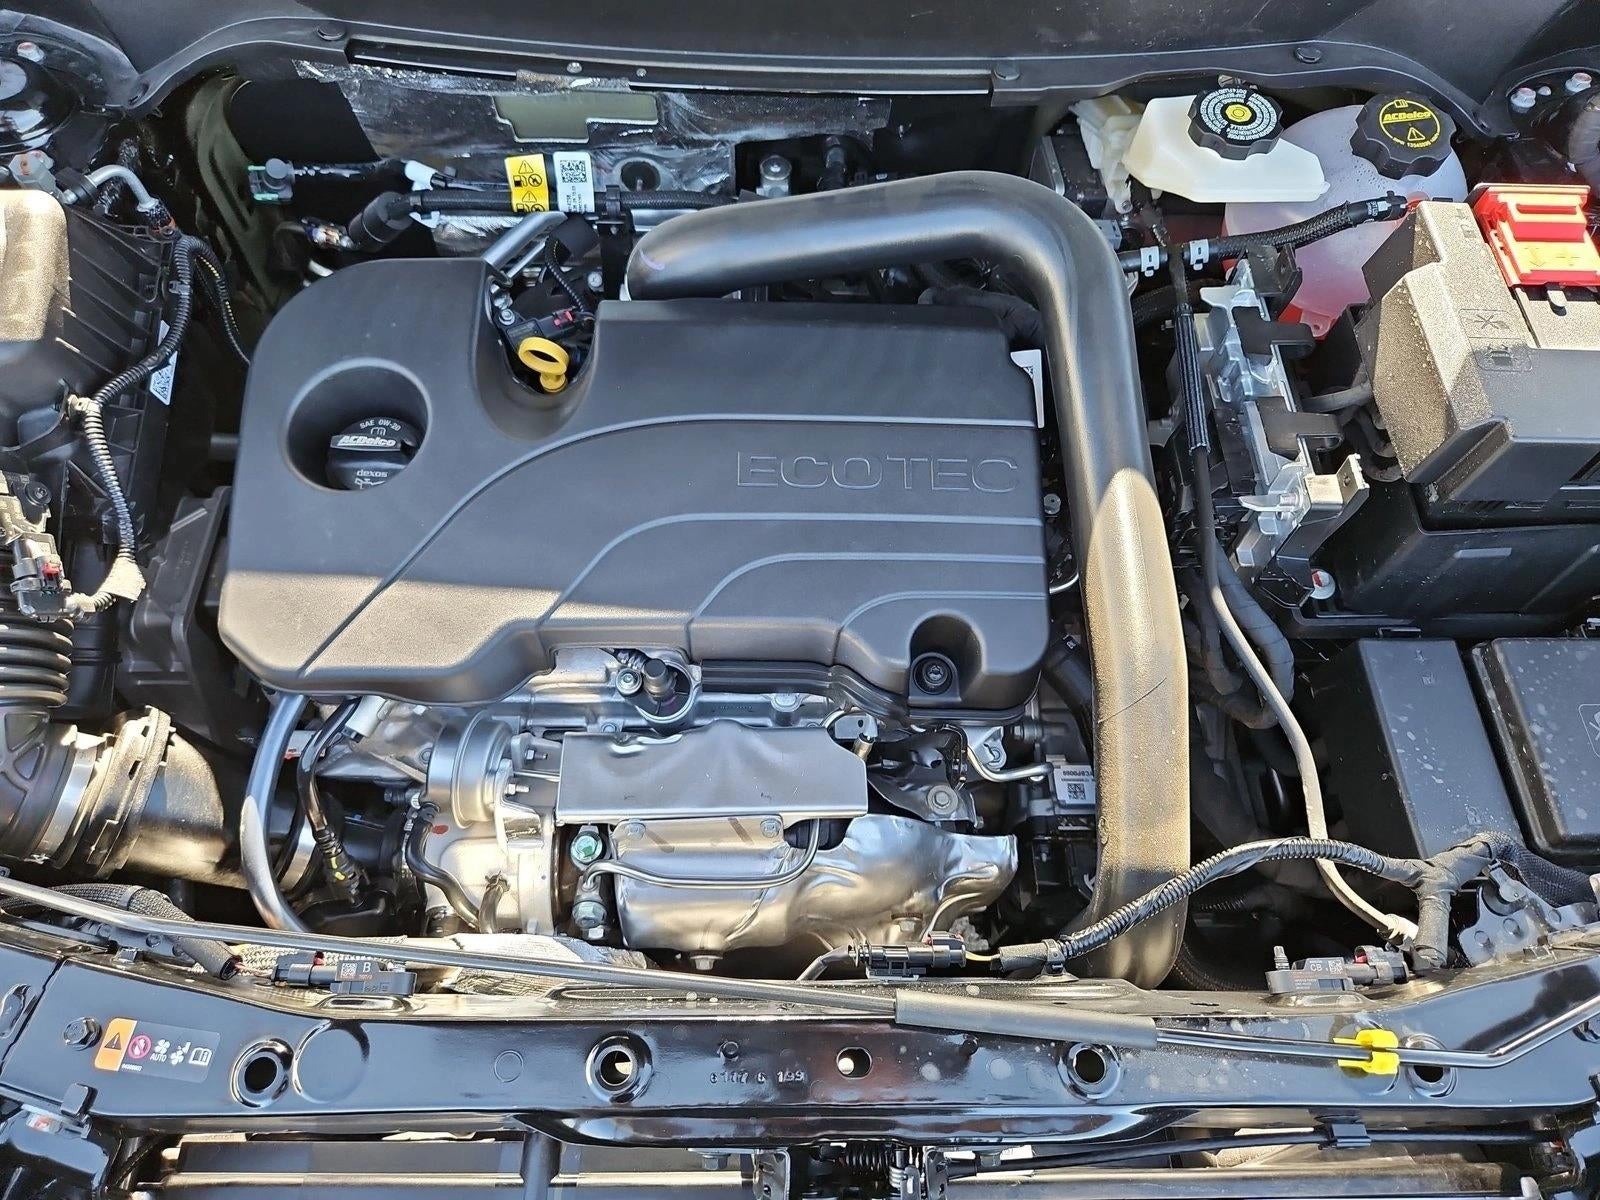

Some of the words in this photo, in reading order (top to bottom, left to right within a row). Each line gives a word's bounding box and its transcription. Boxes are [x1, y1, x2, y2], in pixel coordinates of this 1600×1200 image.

[1383, 111, 1431, 122] ACDelco
[360, 420, 375, 429] SAE
[338, 436, 396, 447] ACDelco
[356, 469, 388, 477] dexos
[737, 451, 1018, 492] ECOTEC
[363, 962, 371, 972] B
[1310, 963, 1322, 971] CB
[150, 1052, 167, 1062] AUTO
